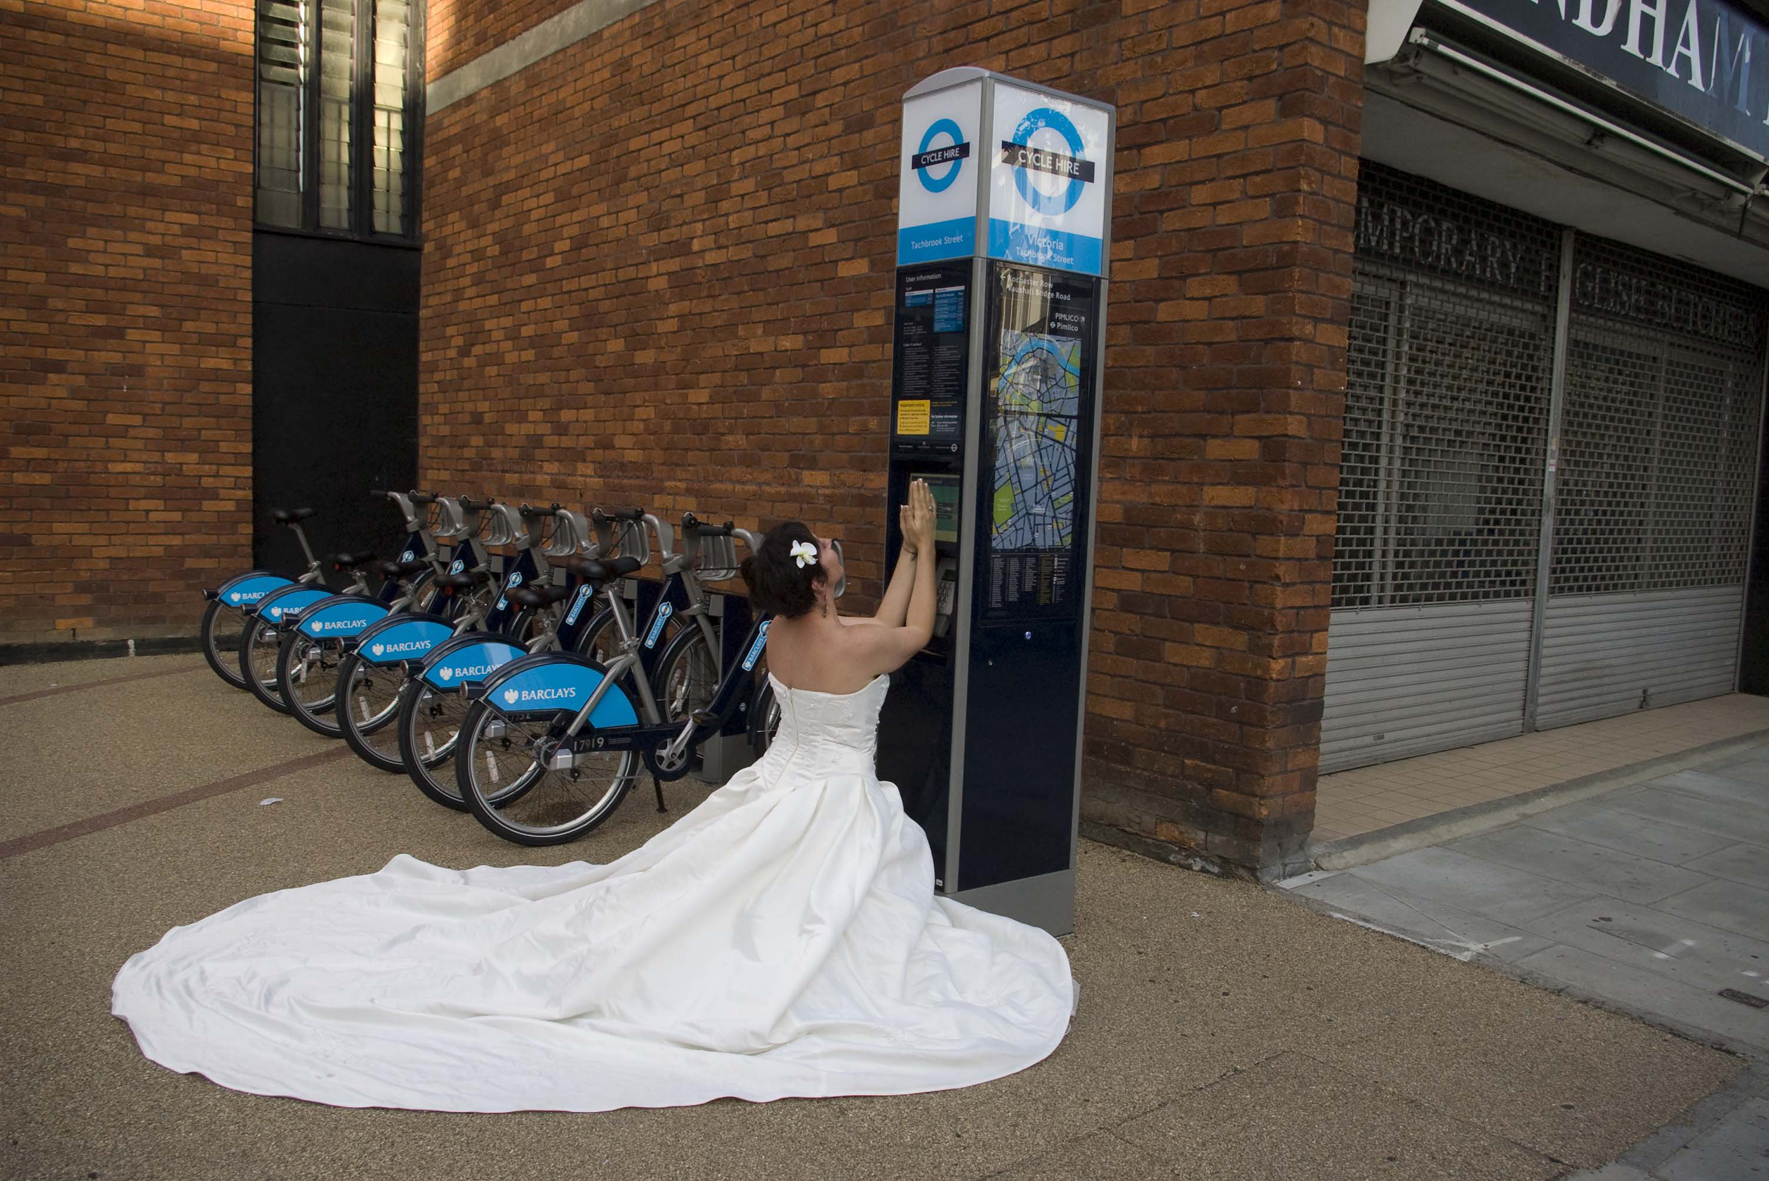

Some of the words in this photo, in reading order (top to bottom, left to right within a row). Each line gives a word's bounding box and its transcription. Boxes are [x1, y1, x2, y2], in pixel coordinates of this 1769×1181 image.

[921, 151, 942, 165] CYCLE
[944, 148, 960, 161] HIRE
[1018, 149, 1052, 170] CYCLE
[1055, 159, 1080, 176] HIRE
[911, 238, 942, 250] Tachbrook
[944, 234, 963, 245] Street
[1027, 233, 1064, 250] Victoria
[1053, 253, 1074, 266] Street
[1040, 279, 1054, 289] Row
[1035, 288, 1055, 299] Bridge
[1055, 291, 1071, 301] Road
[1054, 312, 1079, 323] PIMLICO
[1056, 321, 1079, 332] Pimlico
[324, 619, 367, 630] BARCLAYS
[386, 639, 432, 653] BARCLAYS
[521, 686, 577, 702] BARCLAYS
[573, 736, 605, 753] 17919
